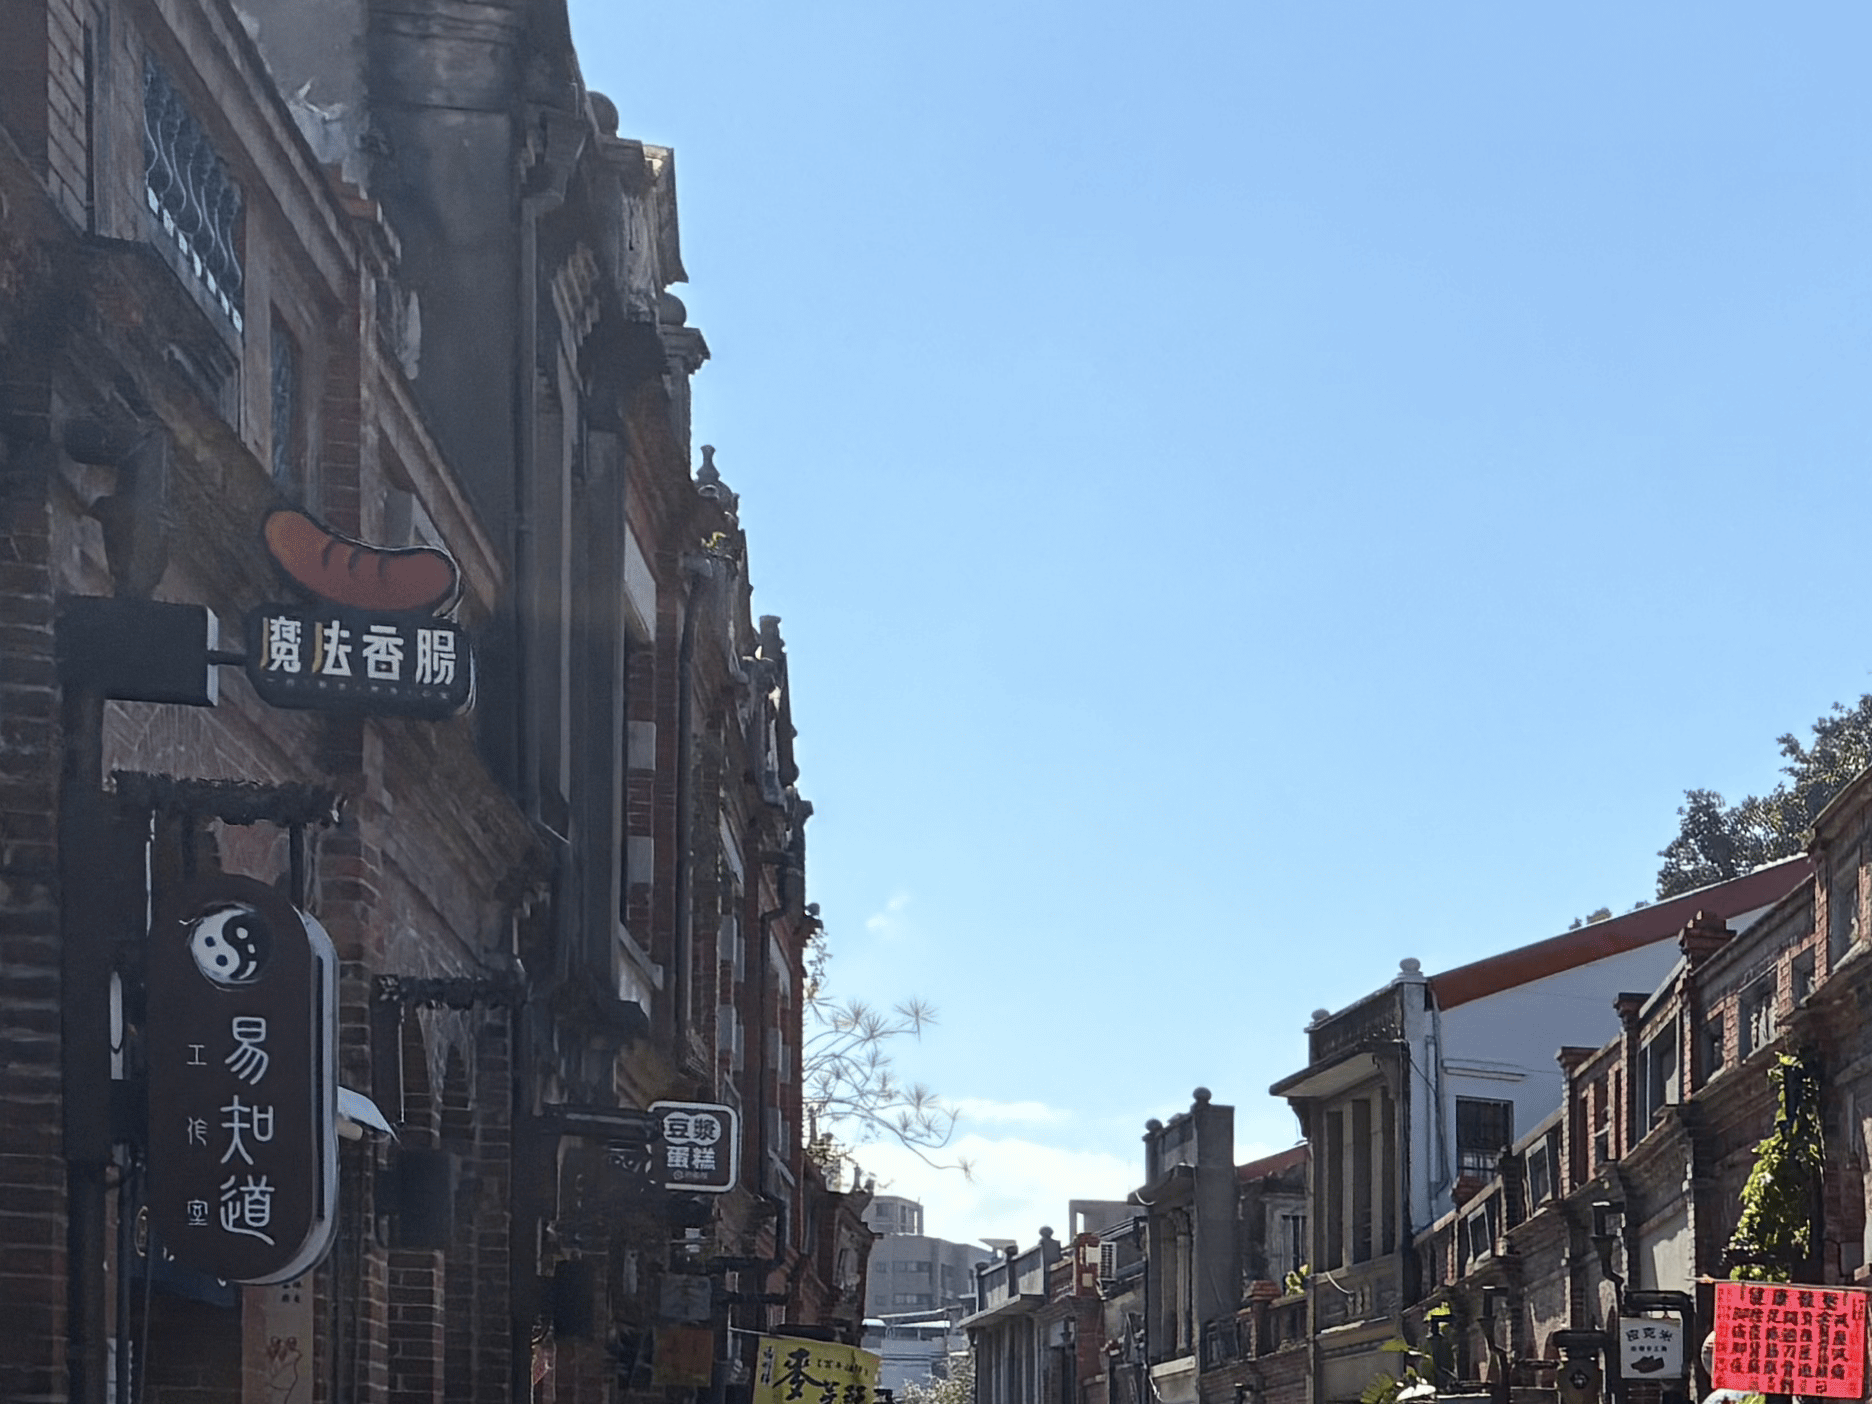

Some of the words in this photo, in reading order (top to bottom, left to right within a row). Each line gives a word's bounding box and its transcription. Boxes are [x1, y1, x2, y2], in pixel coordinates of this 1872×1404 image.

[260, 616, 457, 685] 魔法香腸
[186, 1044, 208, 1226] 工作室
[219, 1016, 275, 1246] 易知道
[666, 1117, 717, 1140] 豆漿
[666, 1146, 716, 1170] 蛋糕
